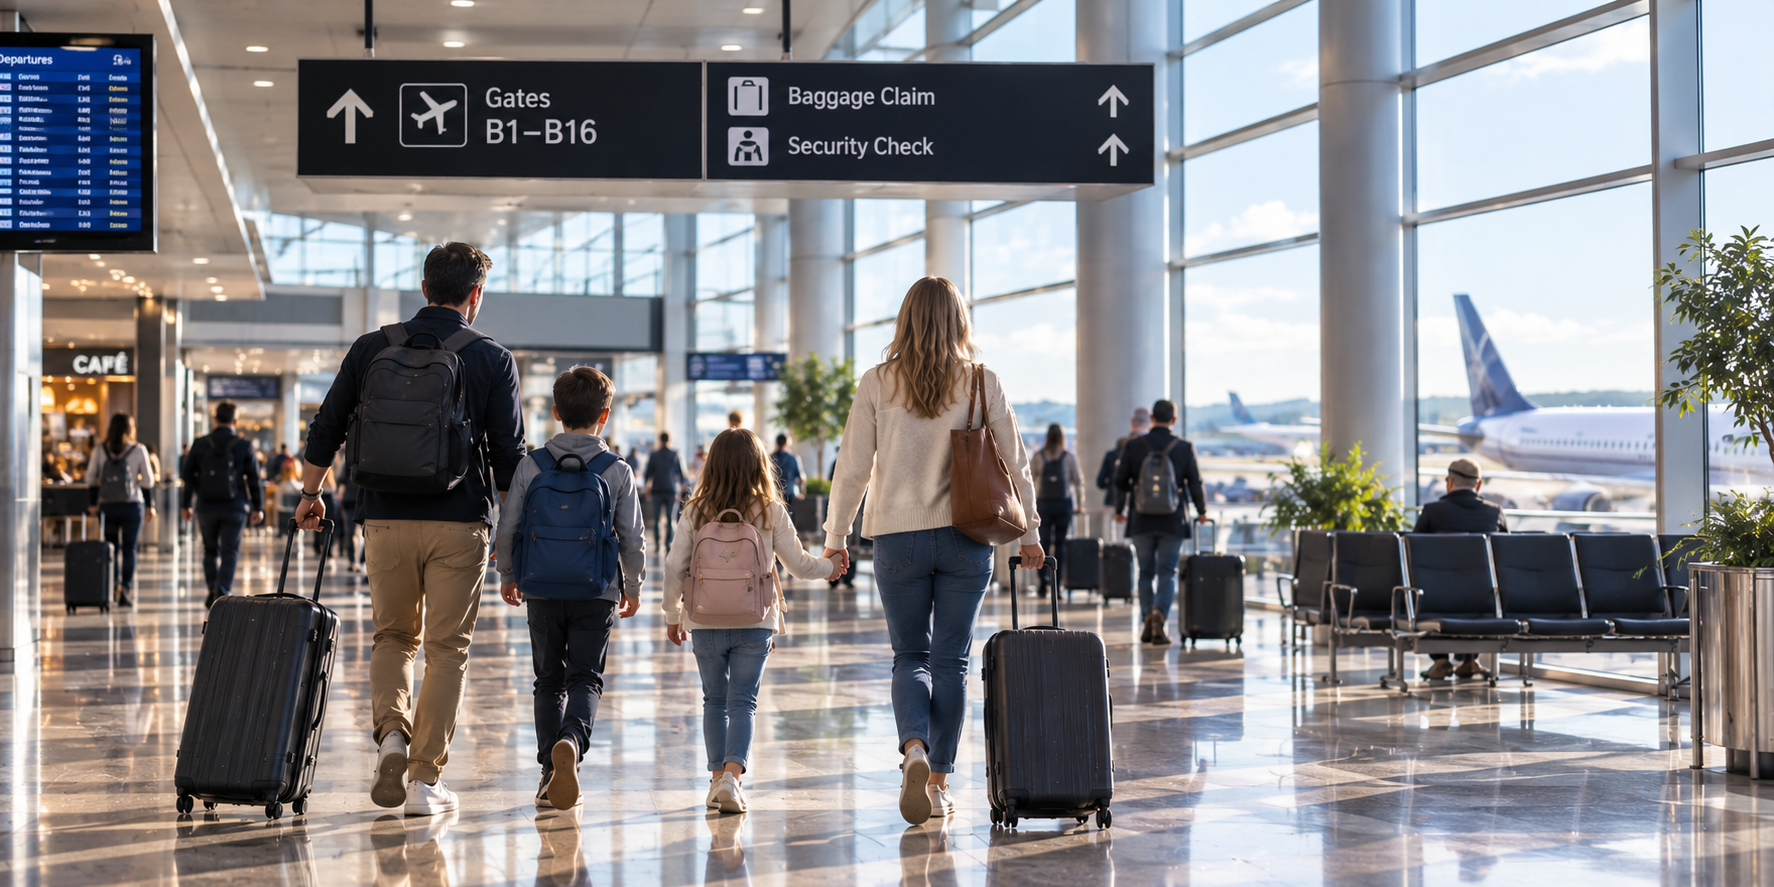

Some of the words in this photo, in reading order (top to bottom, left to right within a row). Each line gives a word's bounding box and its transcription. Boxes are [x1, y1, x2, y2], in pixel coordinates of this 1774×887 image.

[0, 54, 53, 67] Departures
[485, 87, 551, 109] Gates
[788, 87, 875, 110] Baggage
[881, 87, 935, 106] Claim
[788, 135, 869, 160] Security
[874, 136, 934, 156] Check
[72, 351, 128, 375] CAFÉ
